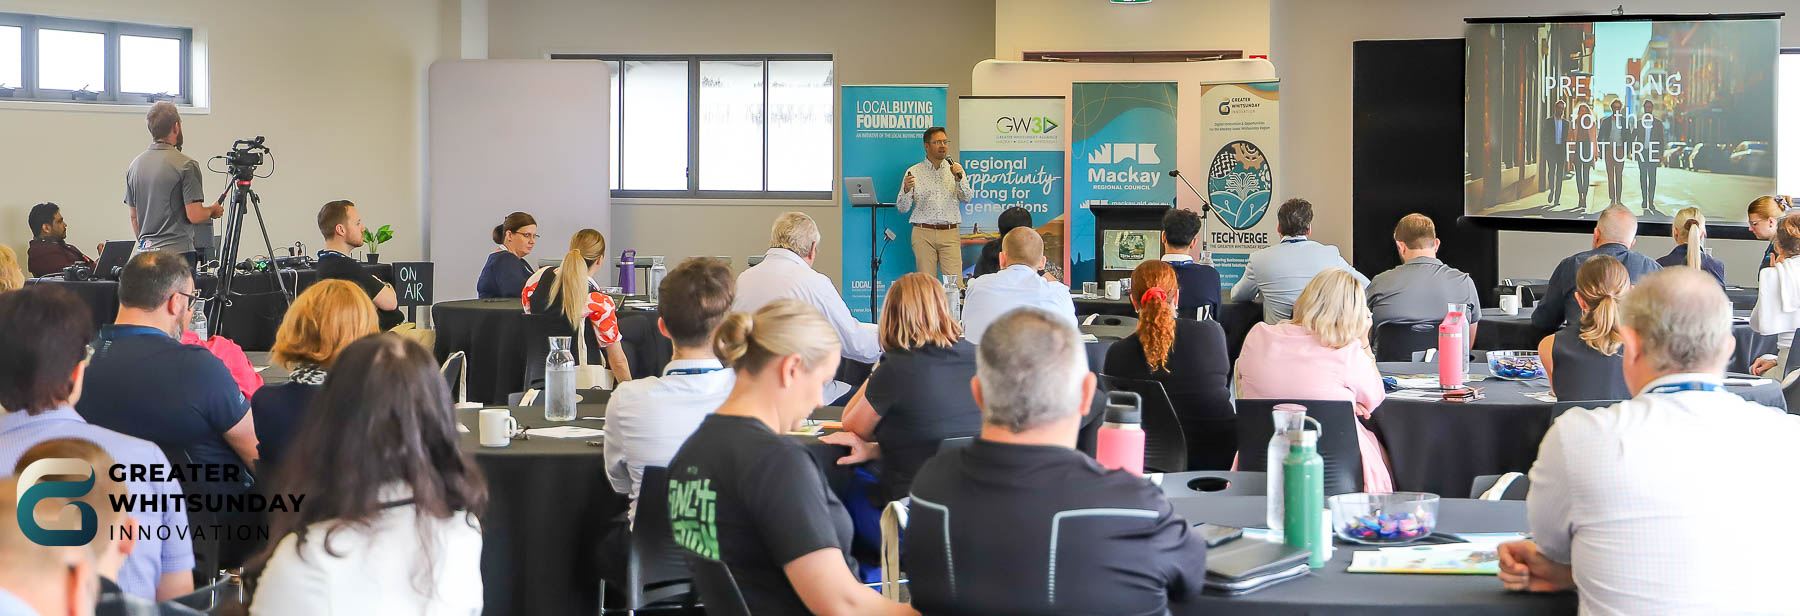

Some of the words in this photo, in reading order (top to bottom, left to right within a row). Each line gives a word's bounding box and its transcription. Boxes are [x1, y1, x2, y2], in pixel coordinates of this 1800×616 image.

[1545, 74, 1682, 97] PRERING
[856, 114, 934, 129] FOUNDATION
[1614, 106, 1654, 130] the
[1566, 141, 1660, 163] FUTURE
[964, 156, 1027, 173] regional
[1088, 165, 1160, 188] Mackay
[971, 188, 1008, 202] trong
[1011, 186, 1031, 199] for
[1211, 232, 1235, 243] TECH
[1237, 232, 1268, 243] VERGE
[400, 266, 417, 281] ON
[404, 282, 425, 302] AIR
[851, 280, 871, 289] LOCAL
